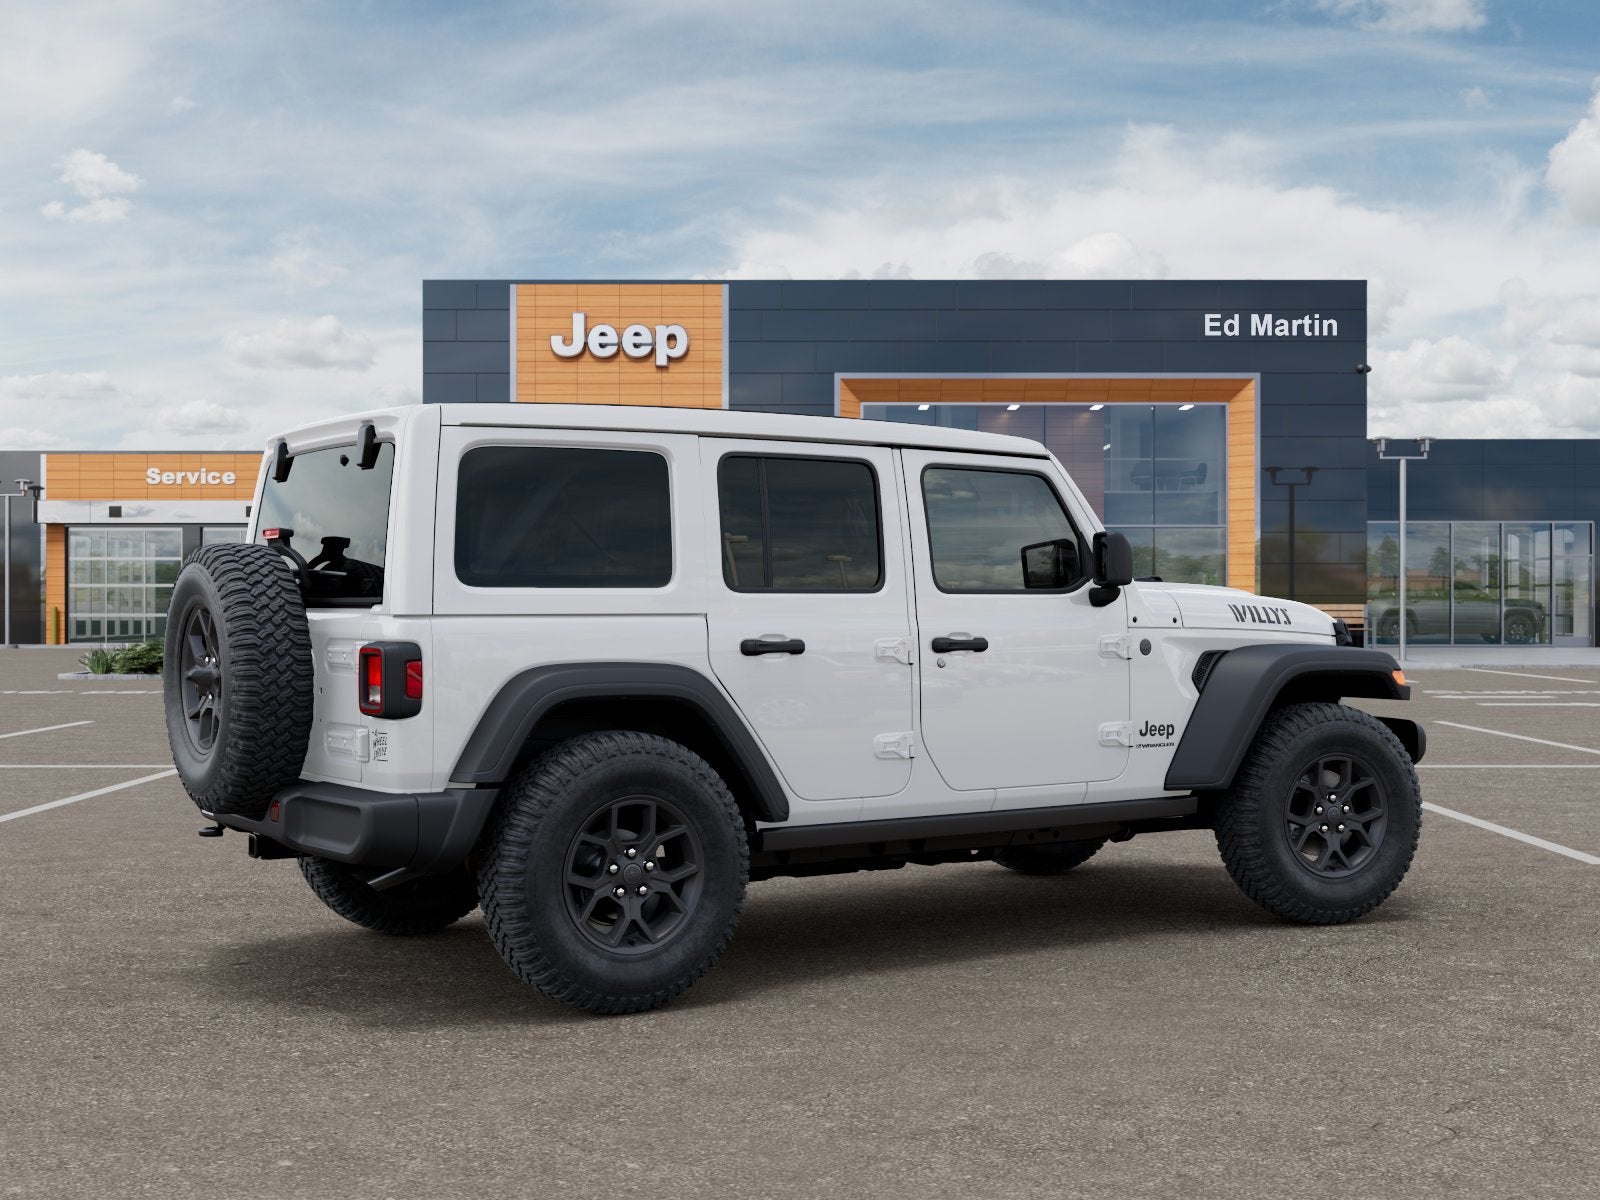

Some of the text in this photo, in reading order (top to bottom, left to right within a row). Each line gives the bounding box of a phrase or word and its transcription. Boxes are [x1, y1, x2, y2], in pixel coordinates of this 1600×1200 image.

[1204, 313, 1338, 336] Ed Martin
[550, 312, 689, 368] Jeep
[146, 467, 236, 485] Service
[1139, 720, 1175, 739] Jeep
